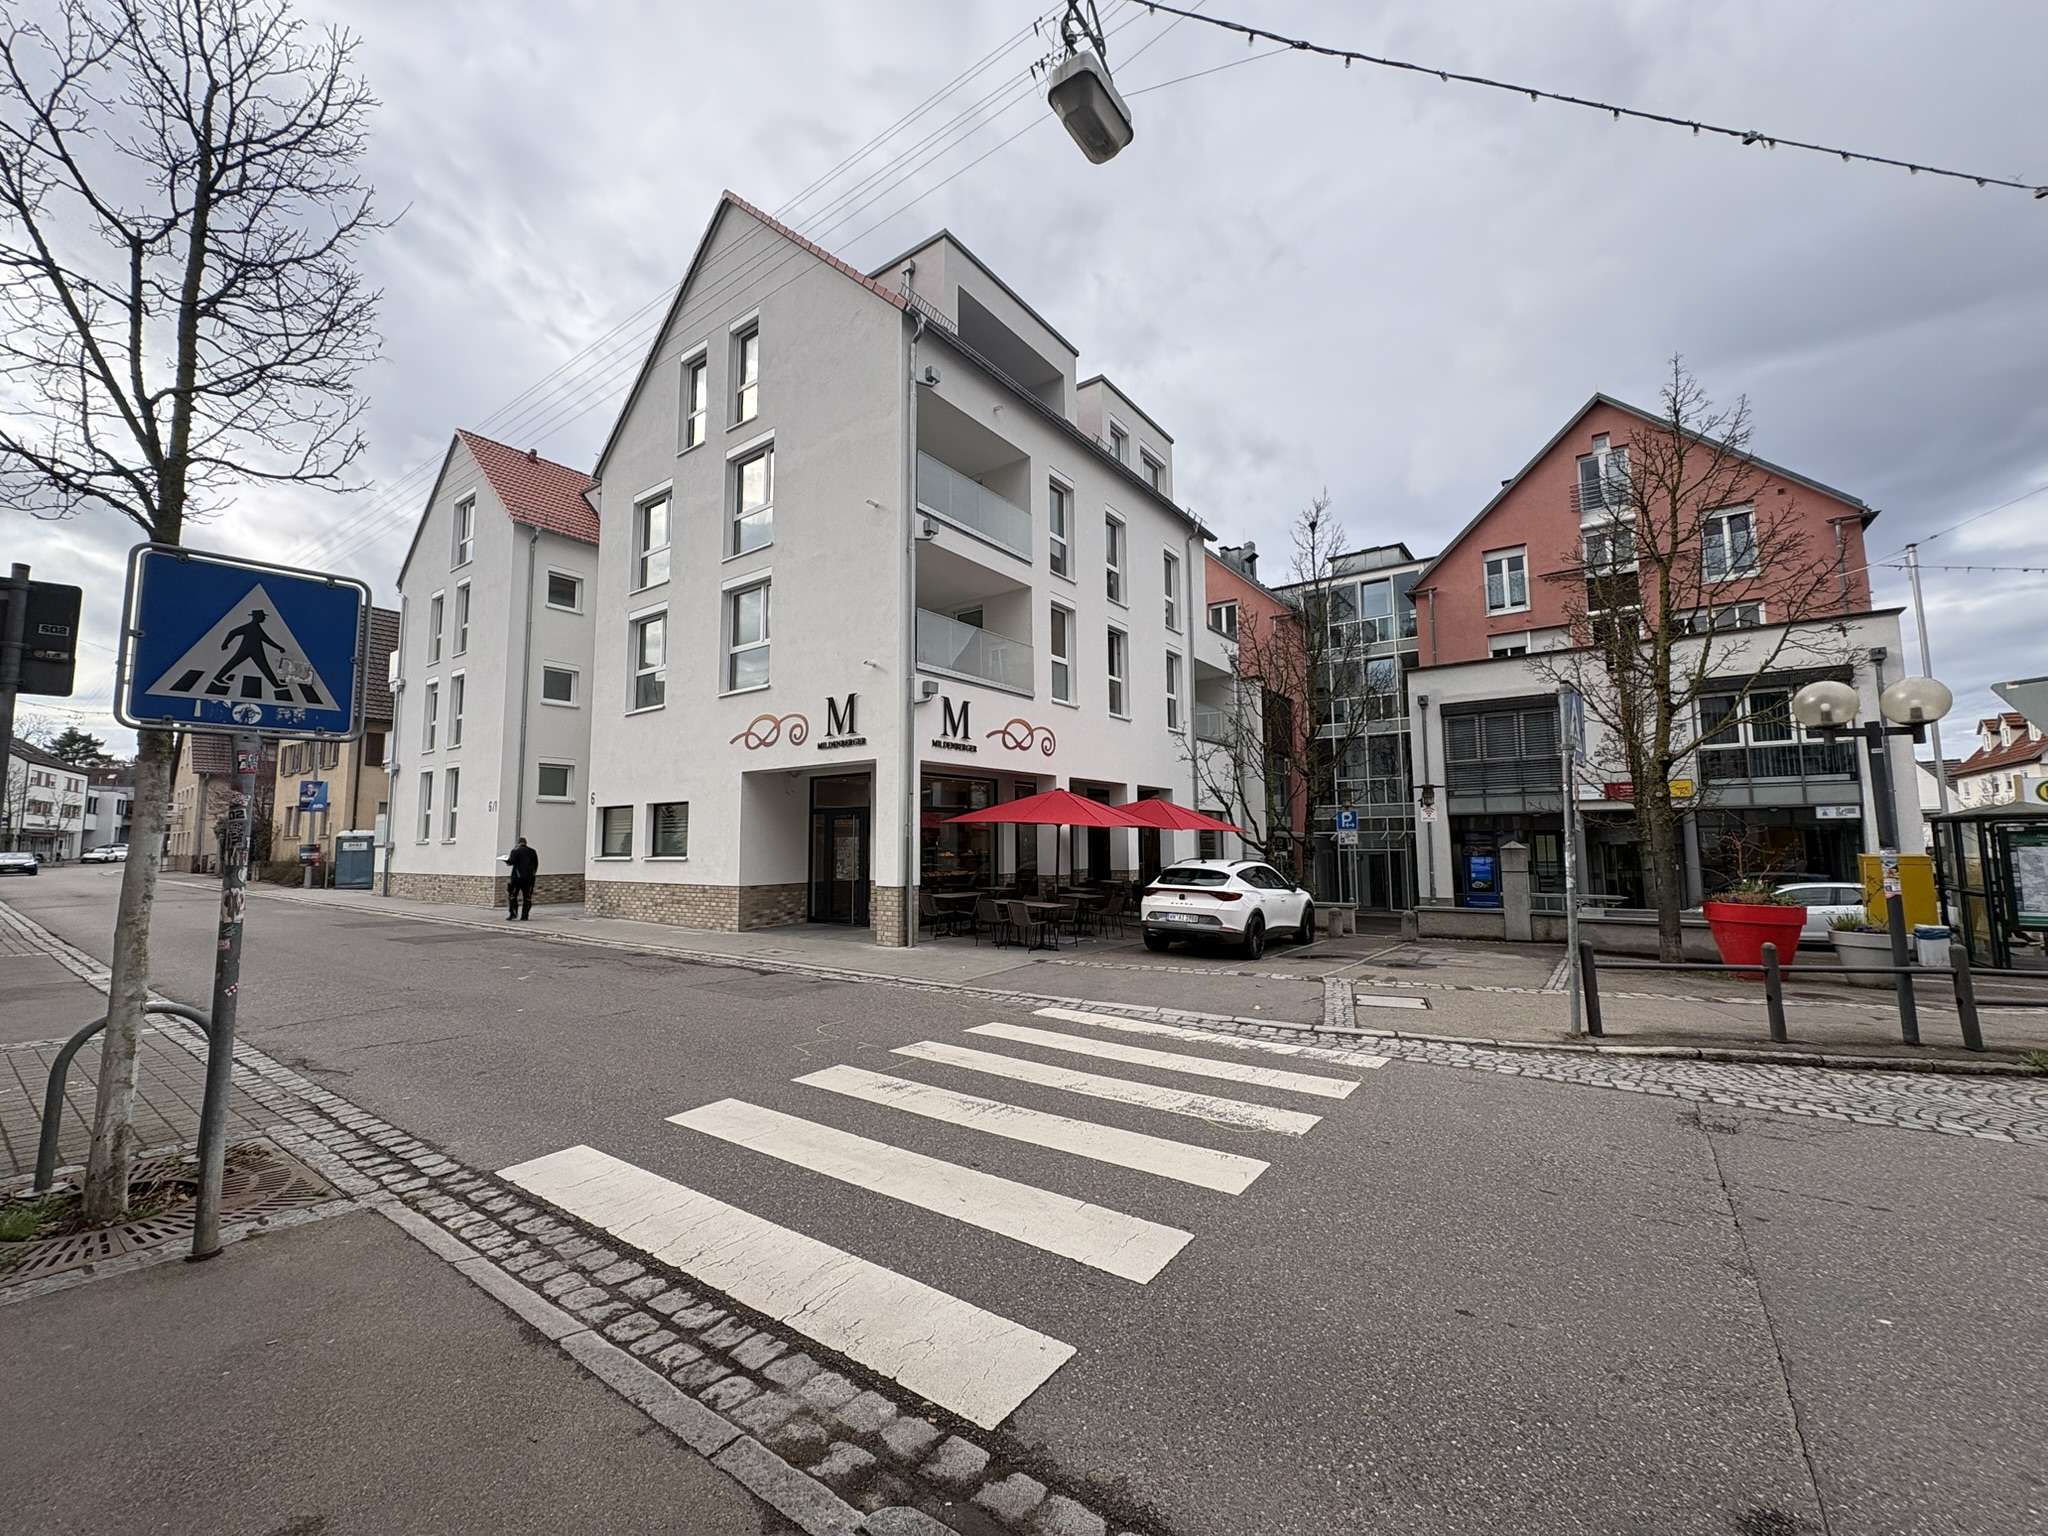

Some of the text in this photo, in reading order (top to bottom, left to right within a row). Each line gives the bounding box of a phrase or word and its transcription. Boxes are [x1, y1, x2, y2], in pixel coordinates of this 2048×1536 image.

[824, 693, 857, 737] M
[940, 696, 971, 740] M
[817, 737, 867, 750] MILDENBERGER
[931, 739, 978, 753] MILDENBERGER
[591, 792, 596, 805] 6
[1341, 812, 1353, 827] P
